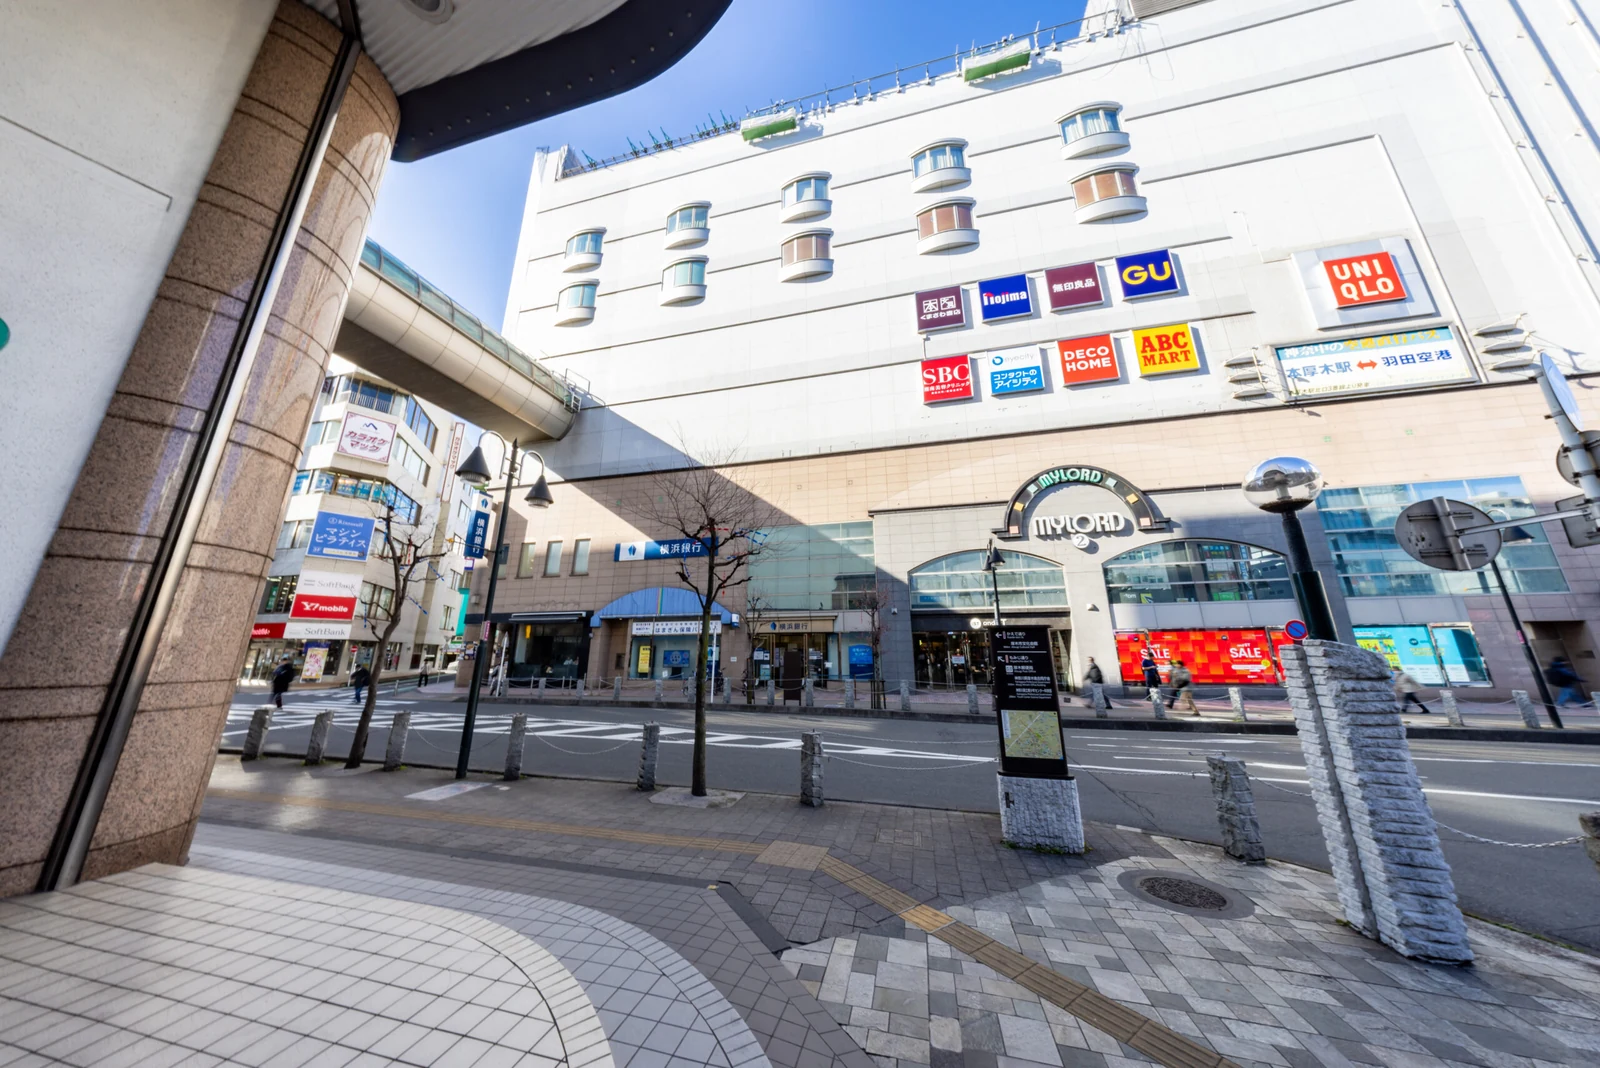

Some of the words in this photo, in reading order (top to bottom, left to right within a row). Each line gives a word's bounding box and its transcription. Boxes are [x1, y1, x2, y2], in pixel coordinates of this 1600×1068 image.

[1121, 260, 1172, 285] GU
[1331, 257, 1384, 281] UNI
[1052, 278, 1096, 293] 無印良品
[1340, 277, 1395, 301] QLO
[1140, 331, 1189, 353] ABC
[1064, 346, 1110, 360] DECO
[1143, 350, 1192, 367] MART
[1066, 357, 1112, 373] HOME
[1286, 361, 1353, 378] 本厚木駅
[1381, 349, 1453, 367] 羽田空港
[922, 363, 970, 385] SBC
[993, 369, 1037, 381] コンタクトの
[994, 378, 1038, 390] アイシティ
[345, 430, 389, 446] カラオケ
[350, 440, 381, 452] マック
[1038, 468, 1103, 488] MYLORD
[1032, 512, 1125, 536] MYLORD
[315, 534, 366, 548] ピラティス
[326, 528, 362, 538] マシン
[472, 518, 486, 554] 横浜銀行
[660, 542, 702, 555] 横浜銀行
[317, 580, 355, 589] SoftBank
[304, 627, 346, 636] SoftBank
[1230, 647, 1262, 658] SALE
